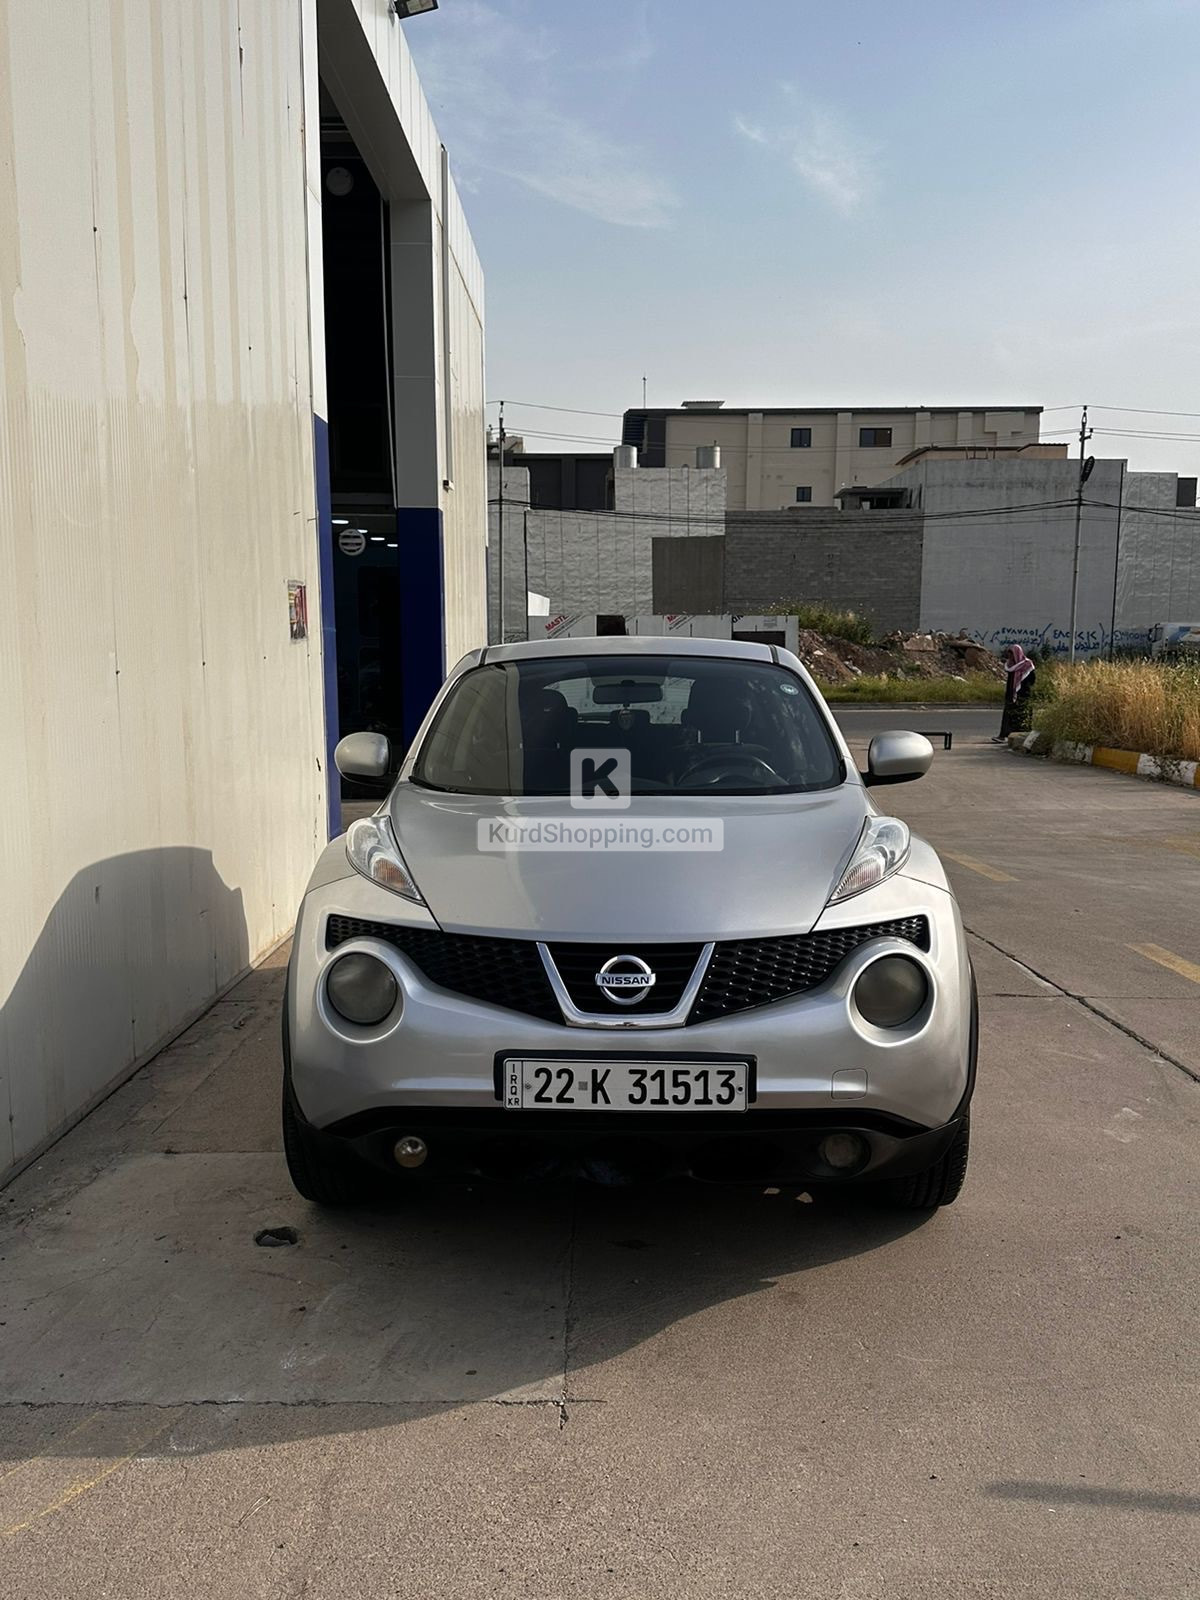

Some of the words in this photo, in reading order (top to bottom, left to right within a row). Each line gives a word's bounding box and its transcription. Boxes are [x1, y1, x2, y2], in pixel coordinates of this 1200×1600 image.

[601, 976, 650, 985] NISSAN
[533, 1067, 575, 1104] 22
[590, 1068, 612, 1105] K
[627, 1069, 736, 1106] 31513
